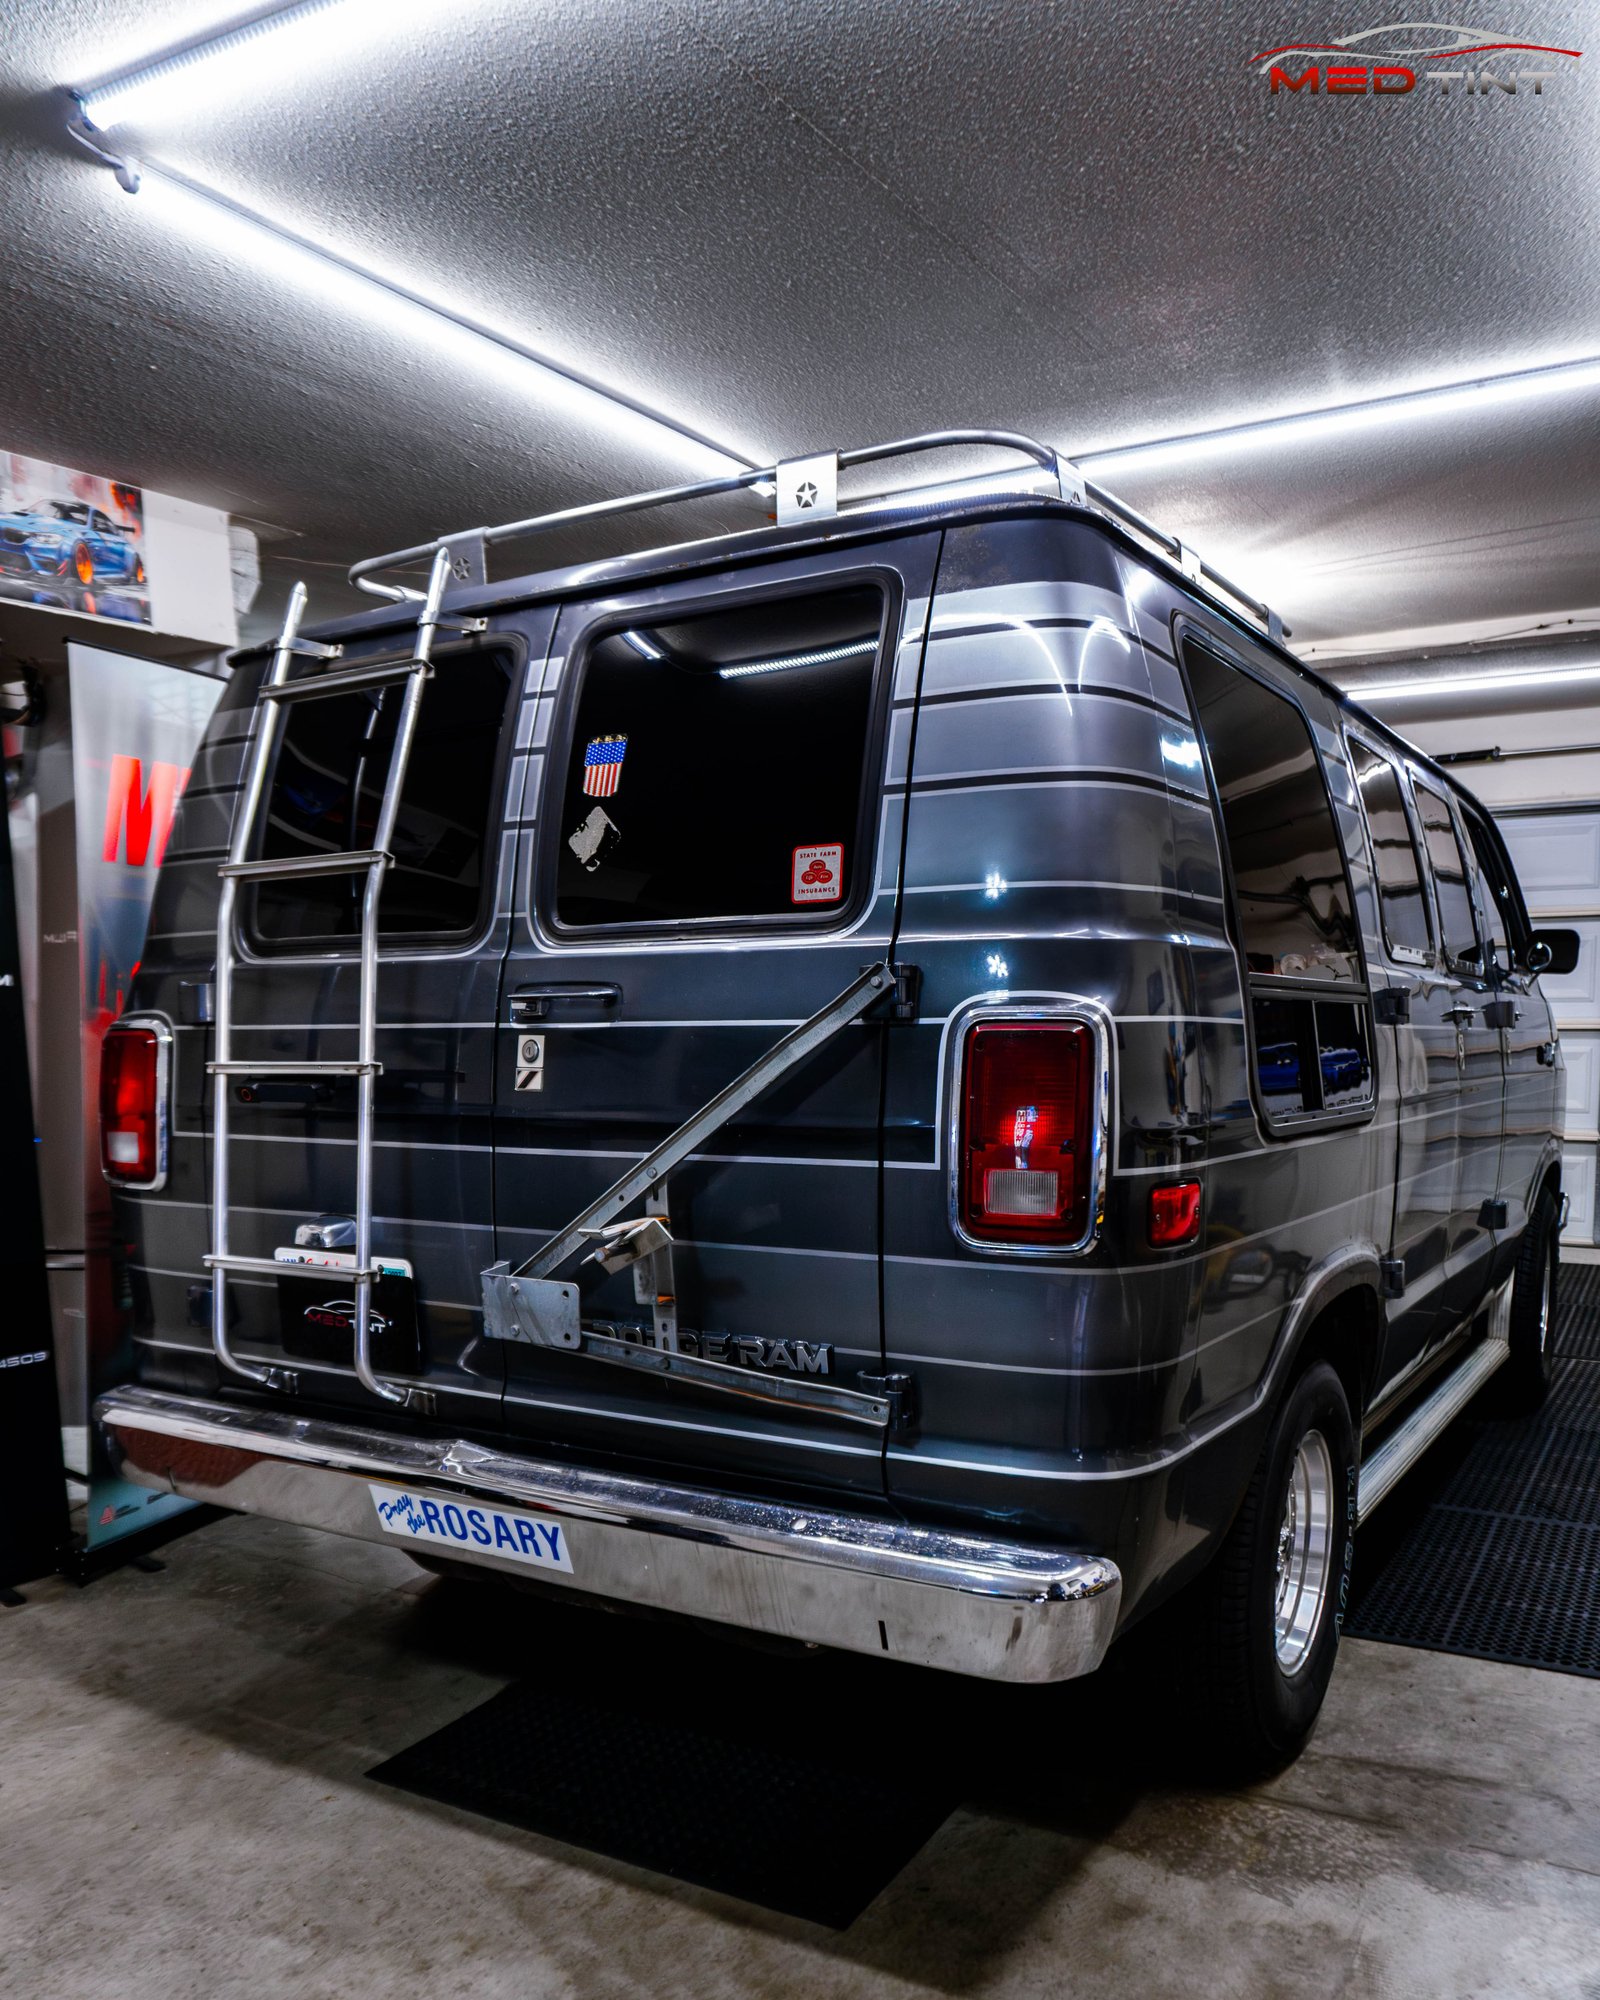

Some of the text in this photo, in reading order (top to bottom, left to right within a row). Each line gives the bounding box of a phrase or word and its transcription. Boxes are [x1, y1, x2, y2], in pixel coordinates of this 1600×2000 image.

[798, 887, 835, 895] INSURANCE
[306, 1312, 386, 1334] MED TNT
[738, 1336, 834, 1374] RAM
[378, 1494, 561, 1562] Pray the ROSARY
